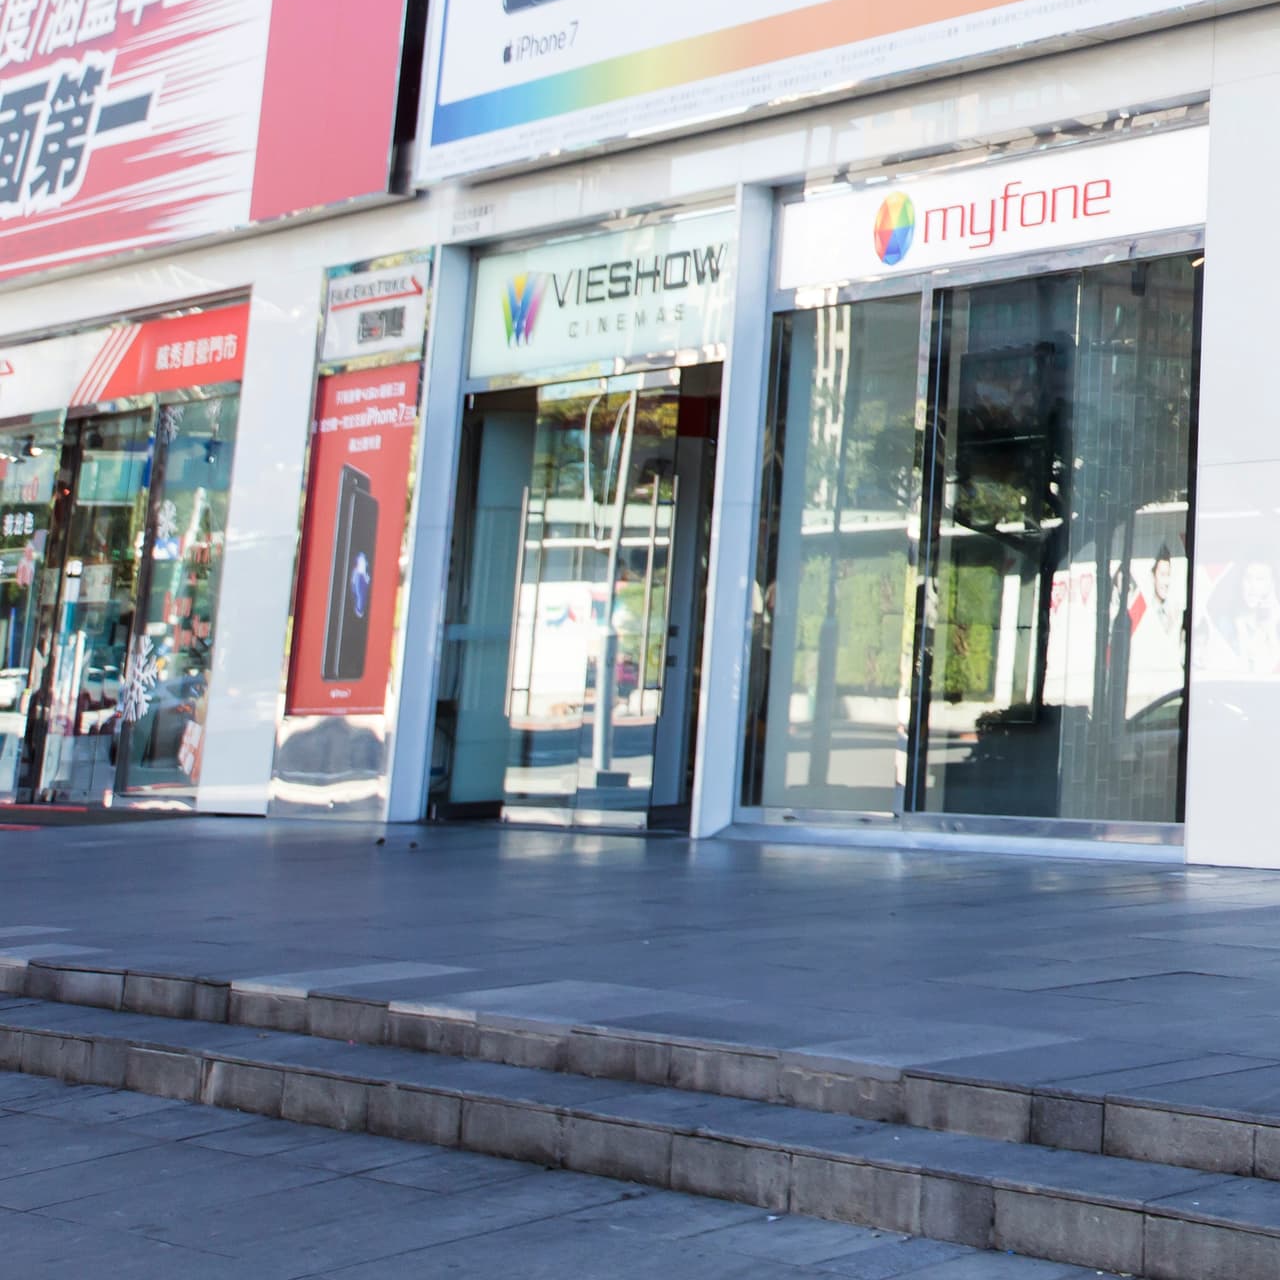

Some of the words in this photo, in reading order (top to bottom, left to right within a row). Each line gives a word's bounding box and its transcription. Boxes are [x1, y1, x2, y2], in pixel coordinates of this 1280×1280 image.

[516, 30, 567, 61] iPhone
[923, 177, 1112, 249] myfone
[552, 242, 728, 308] VIESHOW
[568, 303, 685, 339] CINEMAS
